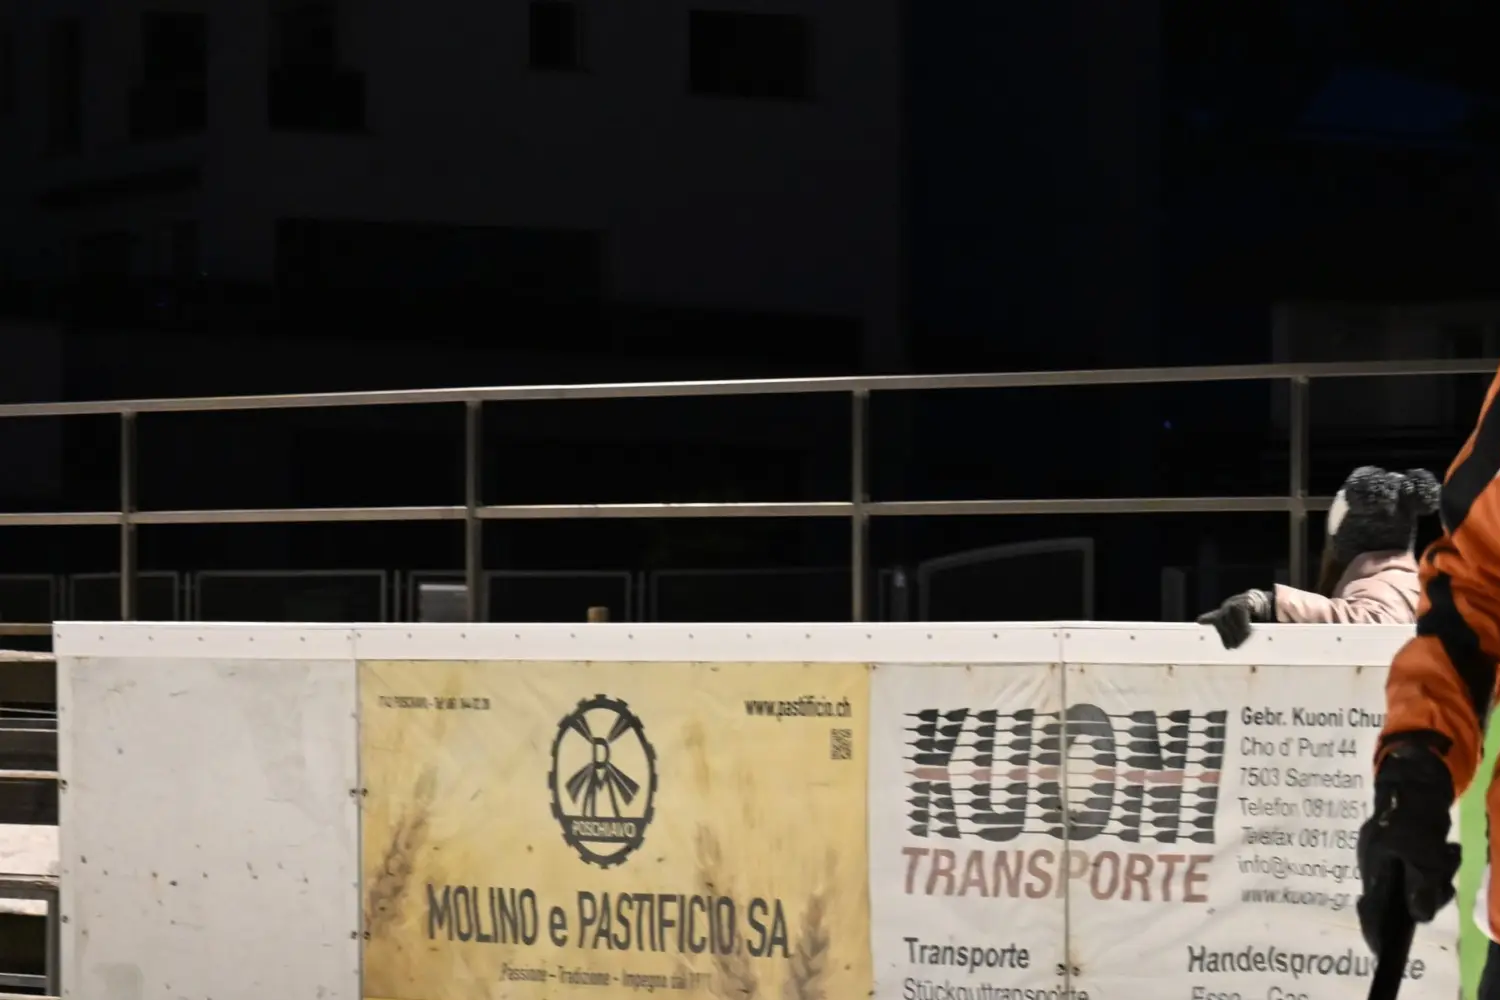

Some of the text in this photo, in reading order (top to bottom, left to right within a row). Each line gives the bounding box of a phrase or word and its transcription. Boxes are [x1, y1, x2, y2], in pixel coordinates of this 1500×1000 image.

[743, 695, 852, 722] www.pastificio.ch
[1241, 706, 1287, 726] Gebr.
[1292, 707, 1344, 727] Kuoni
[1240, 735, 1275, 757] Cho
[1298, 737, 1334, 758] Punt
[1337, 738, 1357, 758] 44
[903, 703, 1228, 844] KUONI
[1240, 767, 1364, 788] 7503 Samedan
[1238, 797, 1298, 817] Telefon
[1241, 825, 1360, 849] Telefax 081/85
[901, 846, 1215, 903] TRANSPORTE
[1237, 854, 1361, 883] info@kuoni-gr.c
[426, 883, 790, 958] MOLINO e PASTIFICIO SA
[903, 936, 1030, 973] Transporte
[1187, 945, 1426, 980] Handelsprodue
